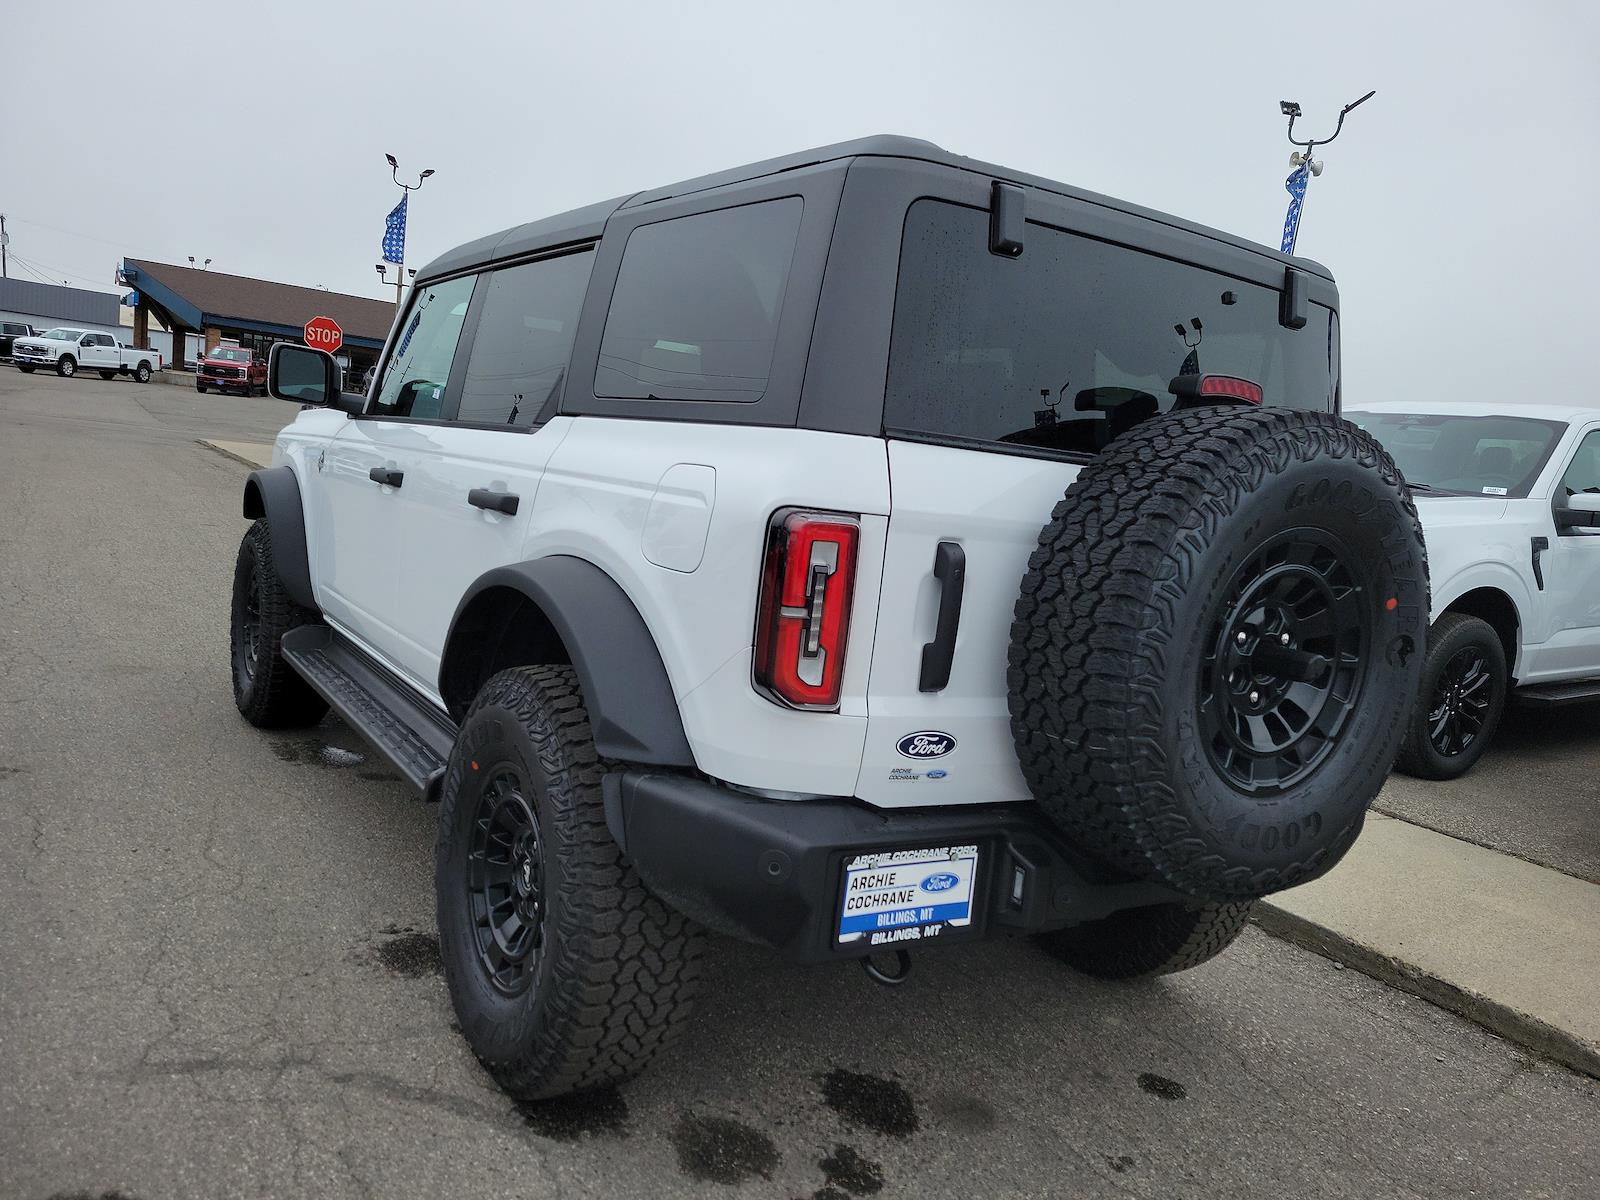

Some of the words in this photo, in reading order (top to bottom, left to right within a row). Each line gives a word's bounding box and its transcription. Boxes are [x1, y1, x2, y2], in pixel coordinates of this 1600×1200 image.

[307, 327, 340, 343] STOP
[1286, 477, 1420, 637] GOODYEAR
[908, 736, 948, 754] Ford
[852, 852, 892, 865] ARCHIE
[892, 847, 949, 860] COCHRANE
[949, 845, 978, 857] FORD
[850, 873, 896, 891] ARCHIE
[847, 890, 914, 910] COCHRANE
[877, 911, 919, 927] BILLINGS,
[920, 907, 934, 921] MT
[871, 927, 921, 945] BILLINGS,
[924, 924, 942, 938] MT
